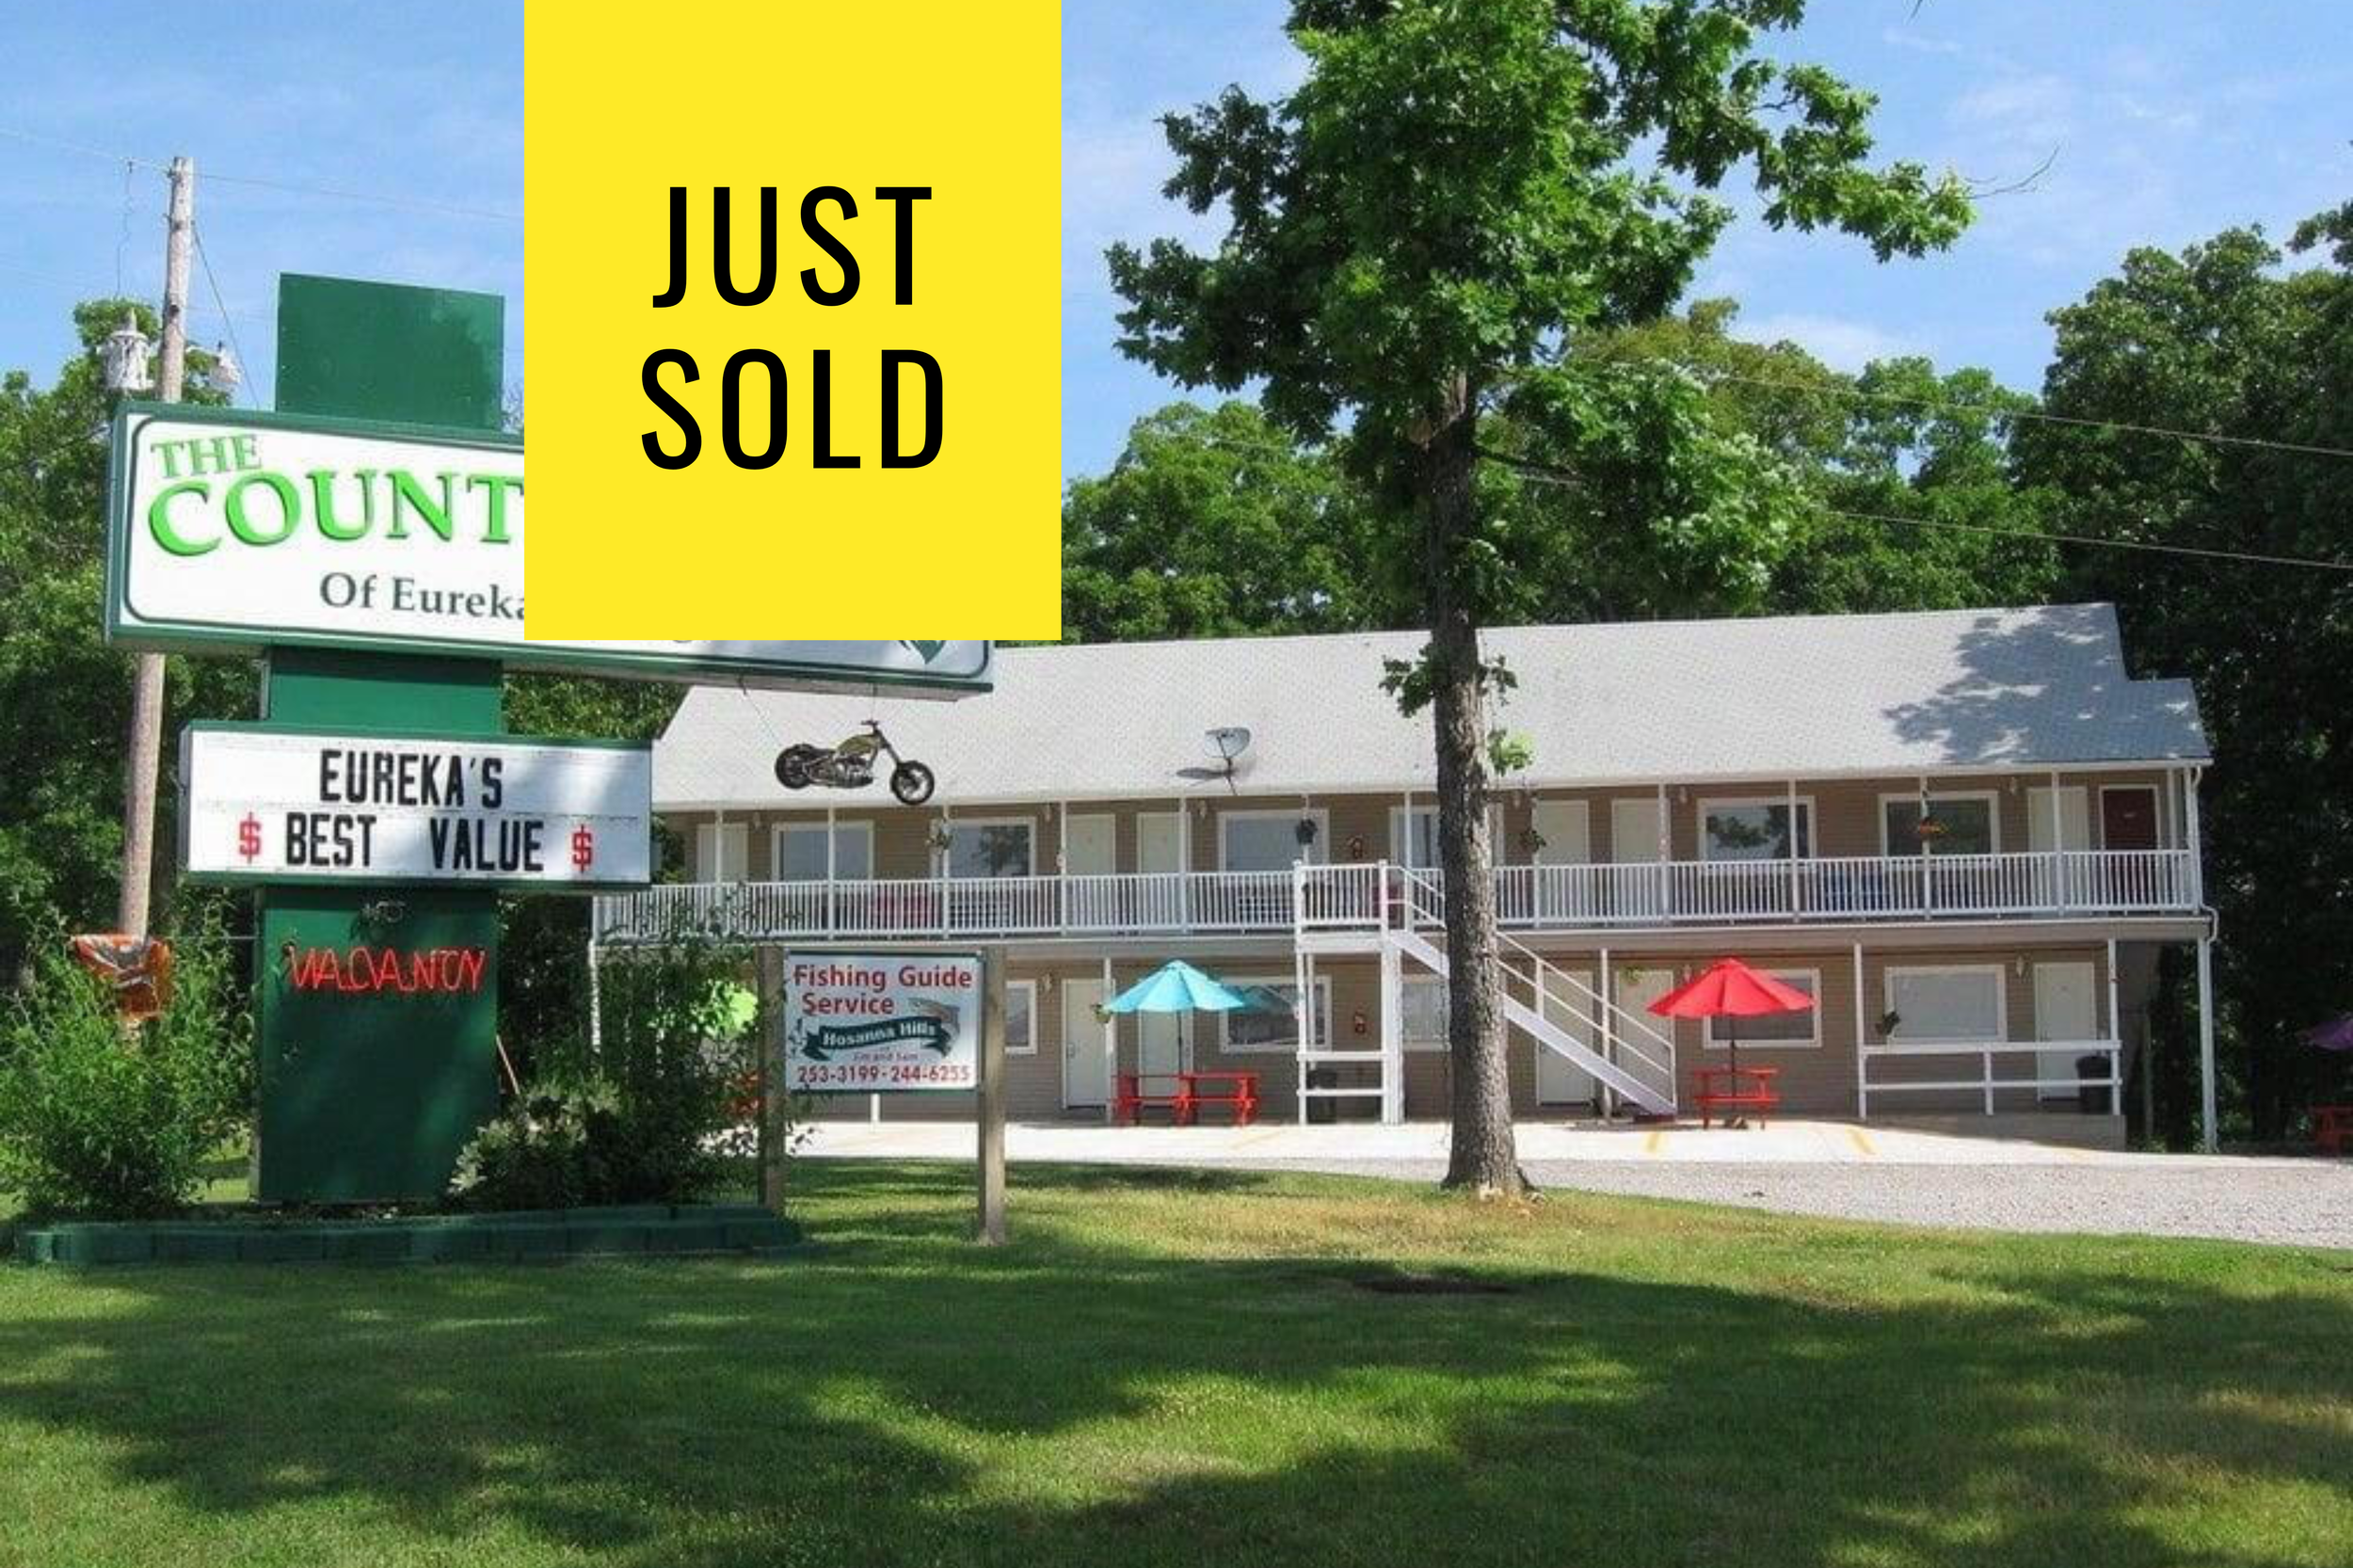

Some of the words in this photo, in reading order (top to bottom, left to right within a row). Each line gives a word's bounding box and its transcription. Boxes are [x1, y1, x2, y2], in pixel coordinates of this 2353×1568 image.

[150, 432, 263, 478] THE
[148, 468, 524, 557] COUNT
[319, 571, 377, 609] Of
[320, 749, 503, 808] EUREKA'S
[238, 811, 262, 864] $
[286, 812, 376, 867] BEST
[430, 816, 544, 872] VALUE
[570, 824, 593, 872] $
[793, 964, 886, 993] Fishing
[898, 966, 973, 987] Guide
[802, 992, 895, 1015] Service
[823, 1027, 895, 1046] Hosanna
[900, 1021, 936, 1036] Hills
[797, 1065, 878, 1083] 253-3199
